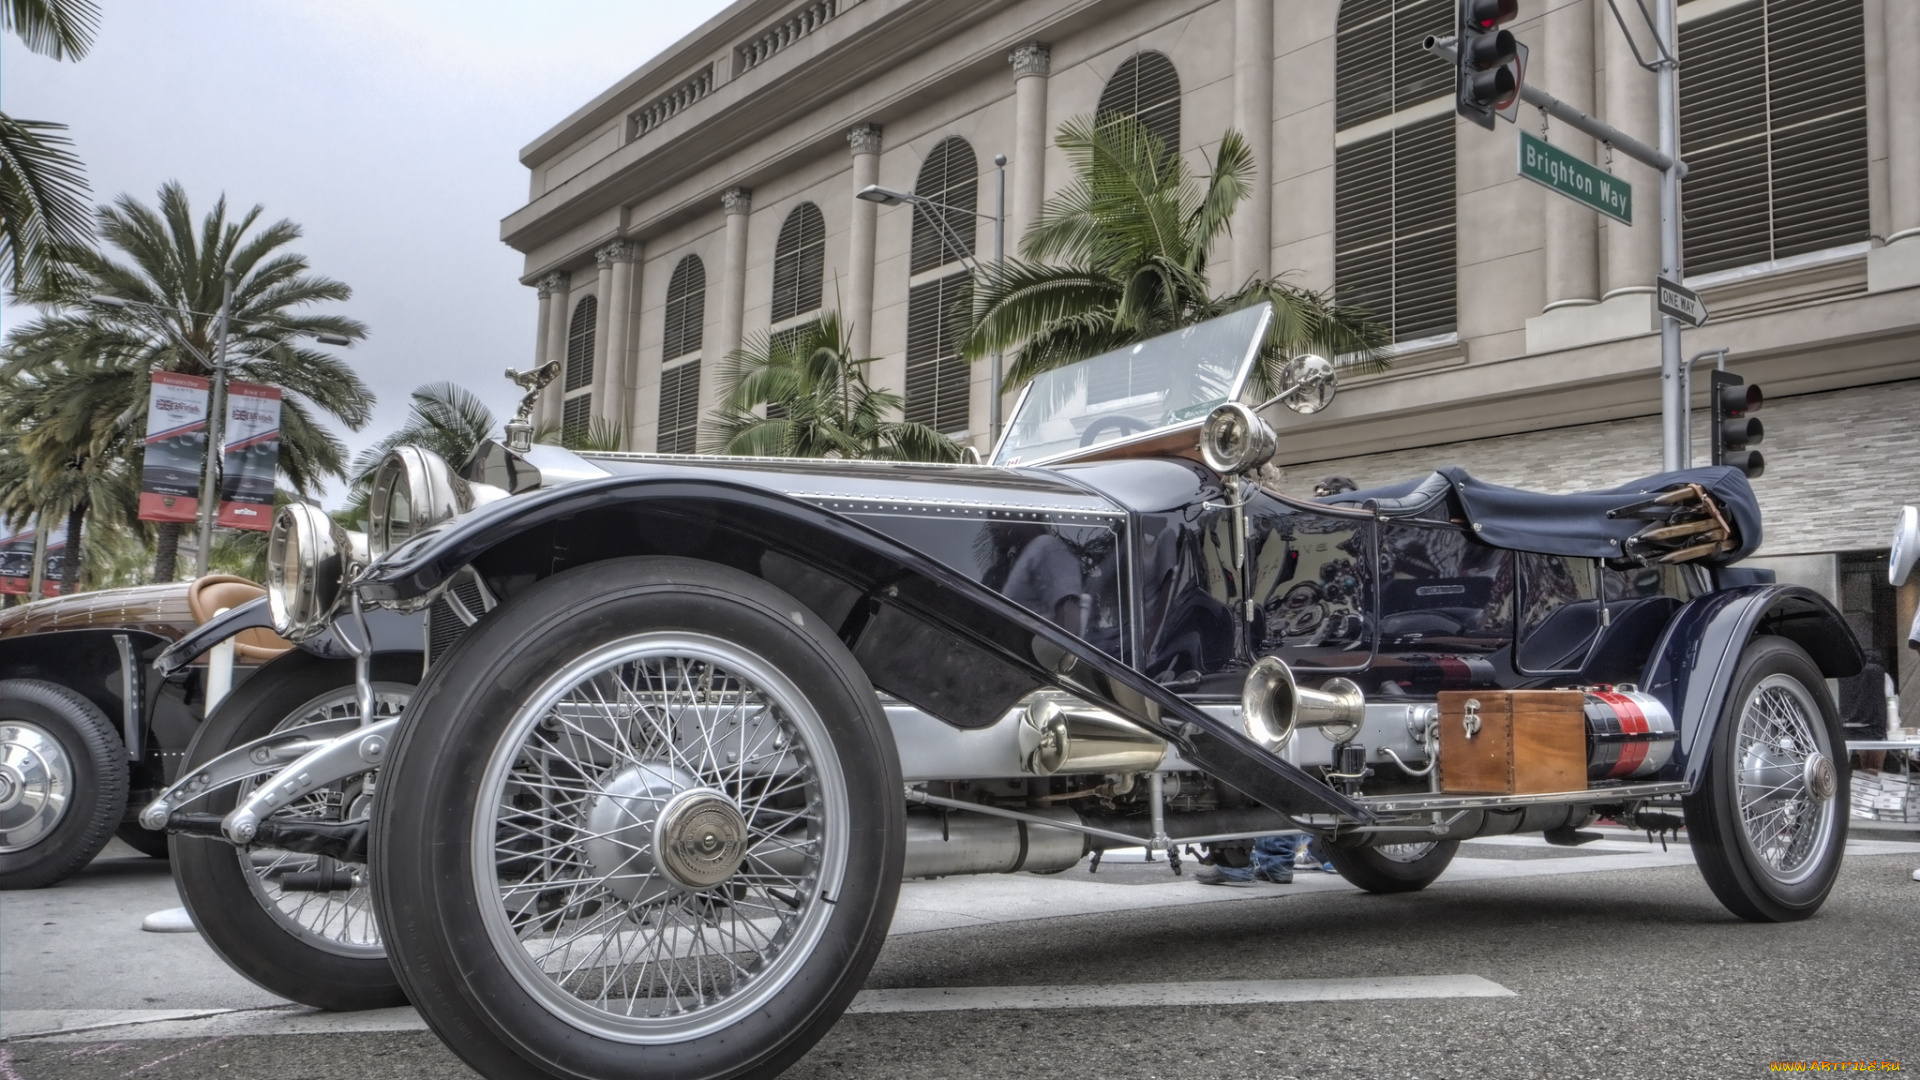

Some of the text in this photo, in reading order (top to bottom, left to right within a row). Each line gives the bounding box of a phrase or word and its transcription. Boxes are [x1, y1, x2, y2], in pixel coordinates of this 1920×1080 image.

[1526, 143, 1627, 216] Brighton Way
[1663, 290, 1695, 315] ONE WAY
